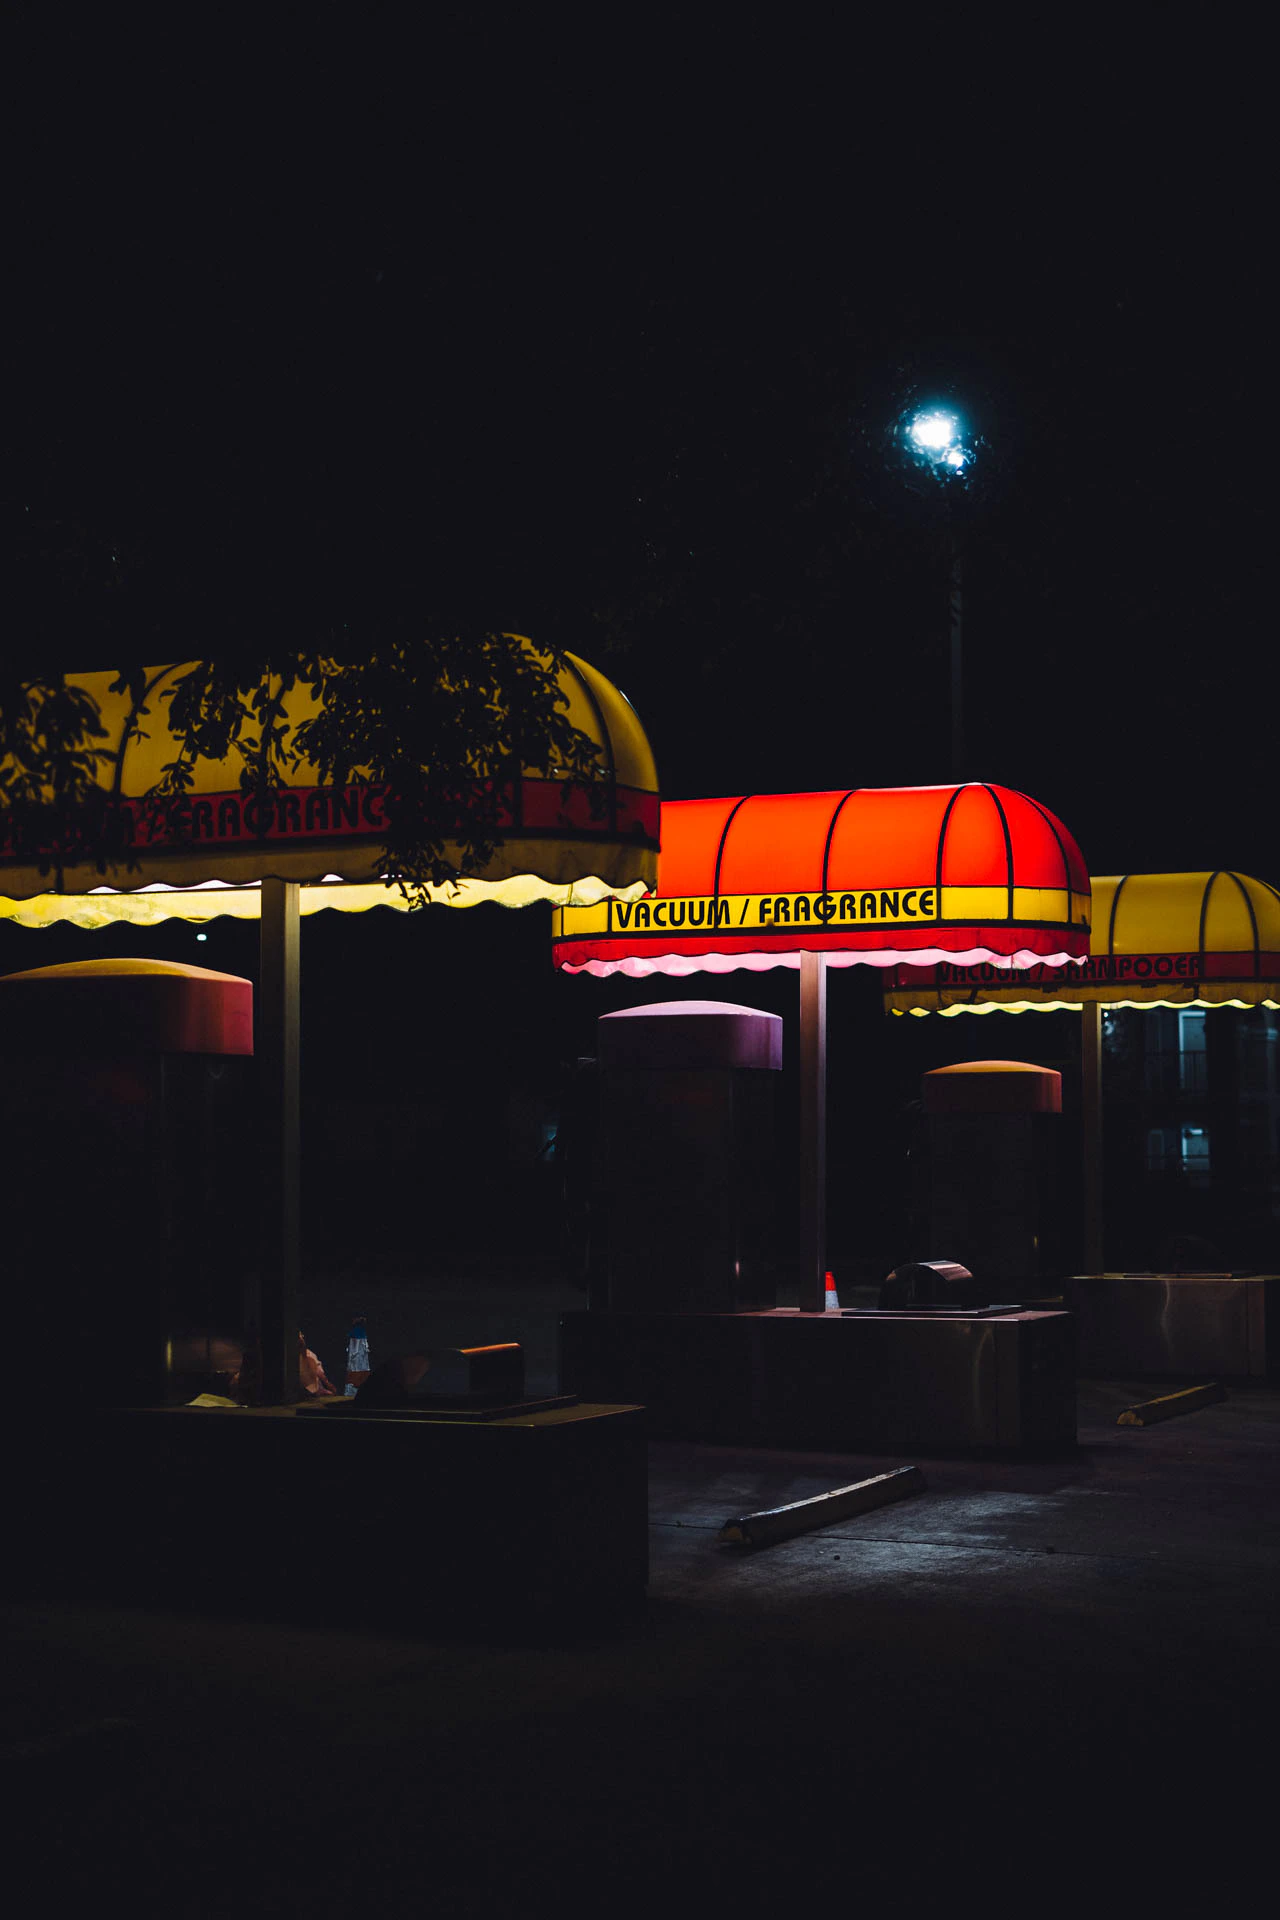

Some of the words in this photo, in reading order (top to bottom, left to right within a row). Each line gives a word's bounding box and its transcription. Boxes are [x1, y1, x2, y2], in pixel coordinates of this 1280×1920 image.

[166, 786, 407, 840] RAGRANC
[616, 900, 730, 928] VACUUM
[739, 898, 750, 925] /
[759, 889, 934, 924] FRAGRANCE
